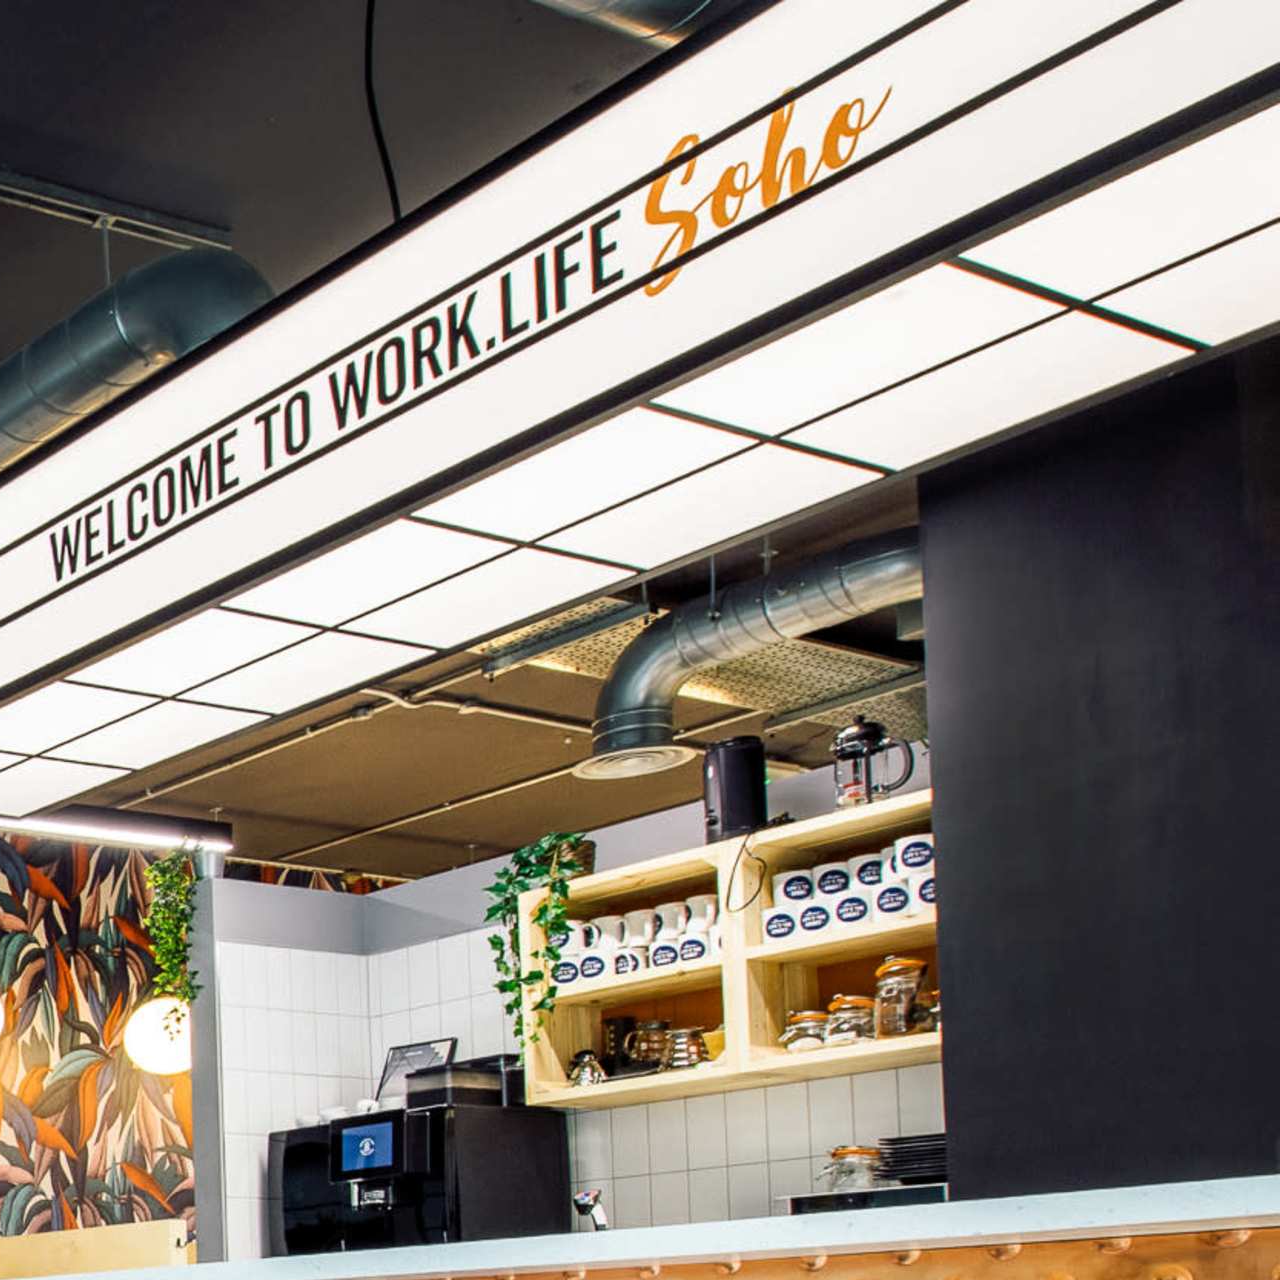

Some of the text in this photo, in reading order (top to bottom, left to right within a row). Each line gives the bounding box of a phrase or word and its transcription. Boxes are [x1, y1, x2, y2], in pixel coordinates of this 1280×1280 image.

[49, 84, 893, 583] WELCOME TO WORK.LIFE Soho
